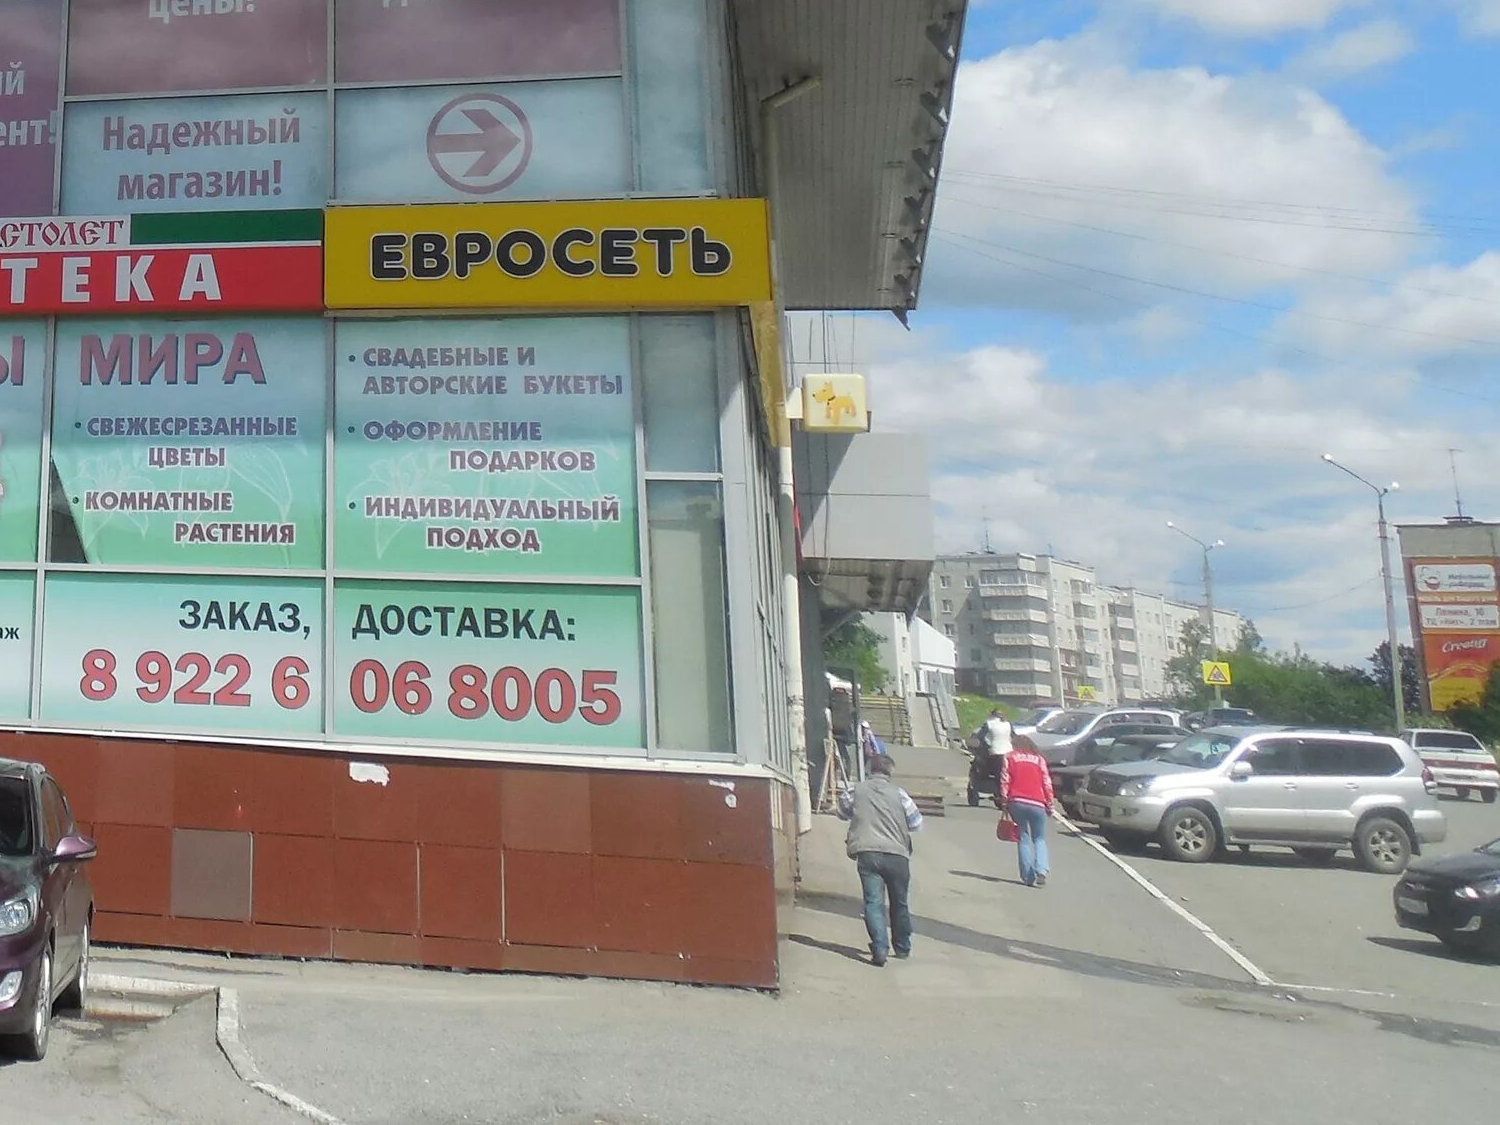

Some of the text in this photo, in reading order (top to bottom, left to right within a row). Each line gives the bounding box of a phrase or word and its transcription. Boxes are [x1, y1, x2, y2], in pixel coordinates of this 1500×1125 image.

[102, 108, 301, 155] Надежный
[117, 160, 282, 200] магазин!
[370, 226, 732, 281] ЕВРОСЕТЬ
[79, 332, 266, 385] МИРА
[363, 346, 536, 368] СВАДЕБНЫЕ И
[363, 375, 623, 396] АВТОРСКИЕ БУКЕТЫ
[86, 416, 298, 437] СВЕЖЕСРЕЗАННЫЕ
[363, 421, 542, 442] ОФОРМЛЕНИЕ
[147, 447, 226, 468] ЦВЕТЫ
[449, 450, 597, 473] ПОДАРКОВ
[84, 490, 234, 512] КОМНАТНЫЕ
[365, 494, 621, 523] ИНДИВИДУАЛЬНЫЙ
[174, 522, 296, 545] РАСТЕНИЯ
[427, 527, 541, 552] ПОДХОД
[178, 600, 576, 642] ЗАКАЗ, ДОСТАВКА:
[80, 649, 621, 726] 8 922 6 06 8005
